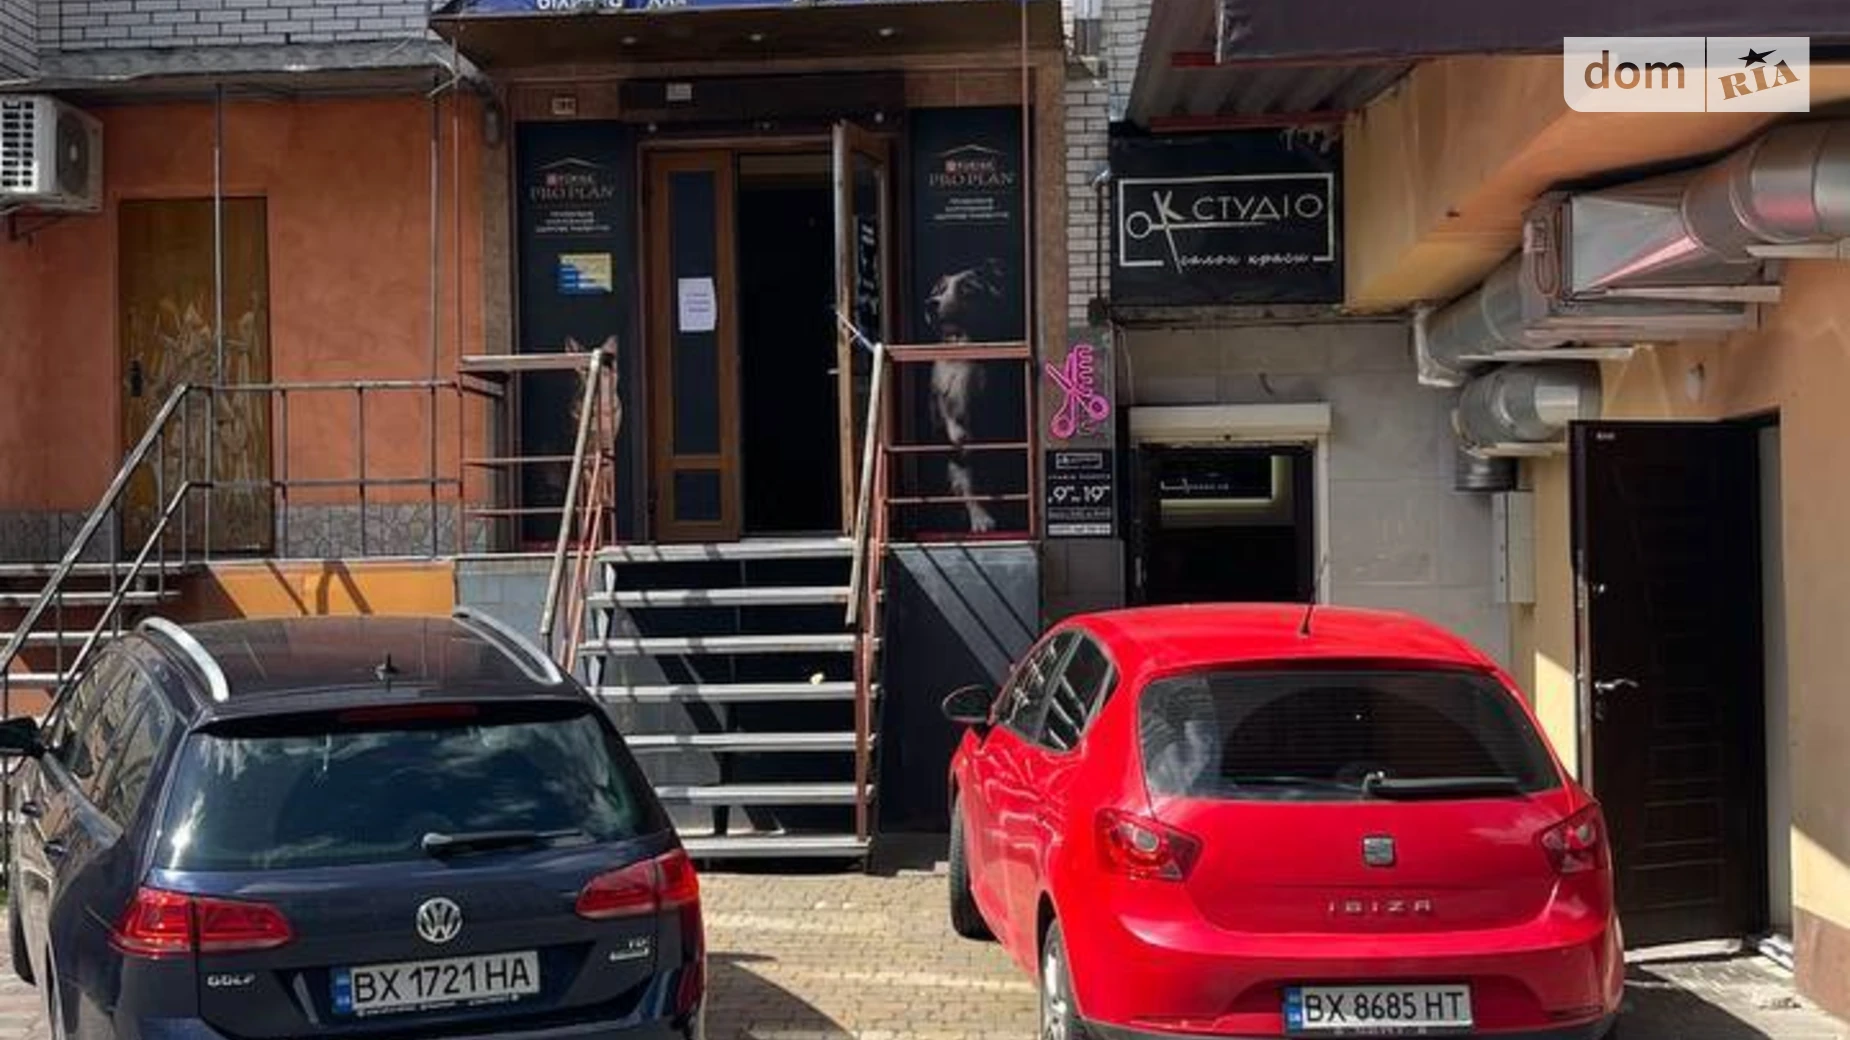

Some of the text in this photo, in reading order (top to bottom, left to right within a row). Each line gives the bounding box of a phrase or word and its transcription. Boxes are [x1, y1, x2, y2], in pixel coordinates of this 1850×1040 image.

[1327, 899, 1432, 912] IBIZA
[353, 956, 531, 1002] BX 1721 HA
[1304, 994, 1347, 1022] BX
[1353, 993, 1417, 1021] 8685
[1425, 992, 1464, 1020] HT
